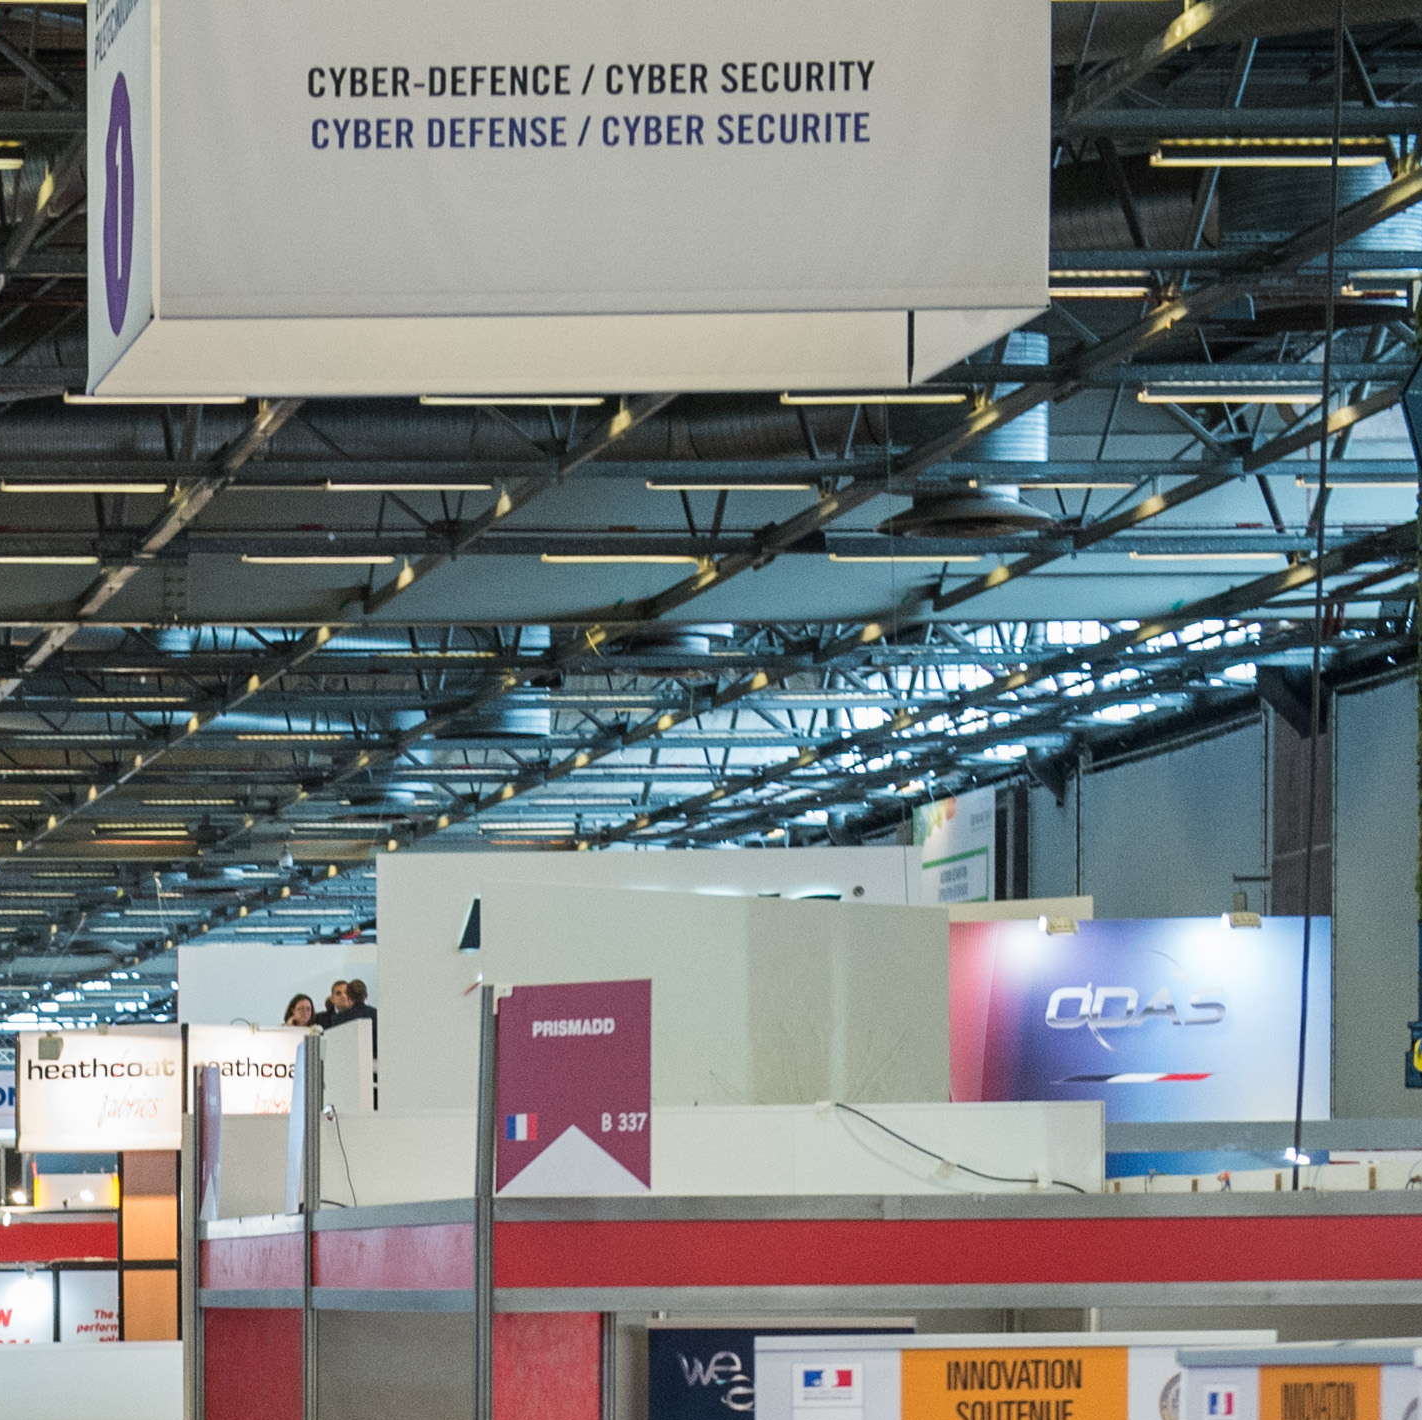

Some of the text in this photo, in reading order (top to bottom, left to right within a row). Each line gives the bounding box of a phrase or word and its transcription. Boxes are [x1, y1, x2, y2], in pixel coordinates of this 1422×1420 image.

[308, 60, 875, 98] CYBER-DEFENCE / CYBER SECURITY
[311, 112, 870, 149] CYBER DEFENSE / CYBER SECURITE
[531, 1017, 616, 1038] PRISMADD
[27, 1058, 175, 1080] heathcoat
[601, 1112, 647, 1132] B 337
[94, 1309, 113, 1319] The
[77, 1323, 119, 1334] perform
[946, 1359, 1082, 1390] INNOVATION
